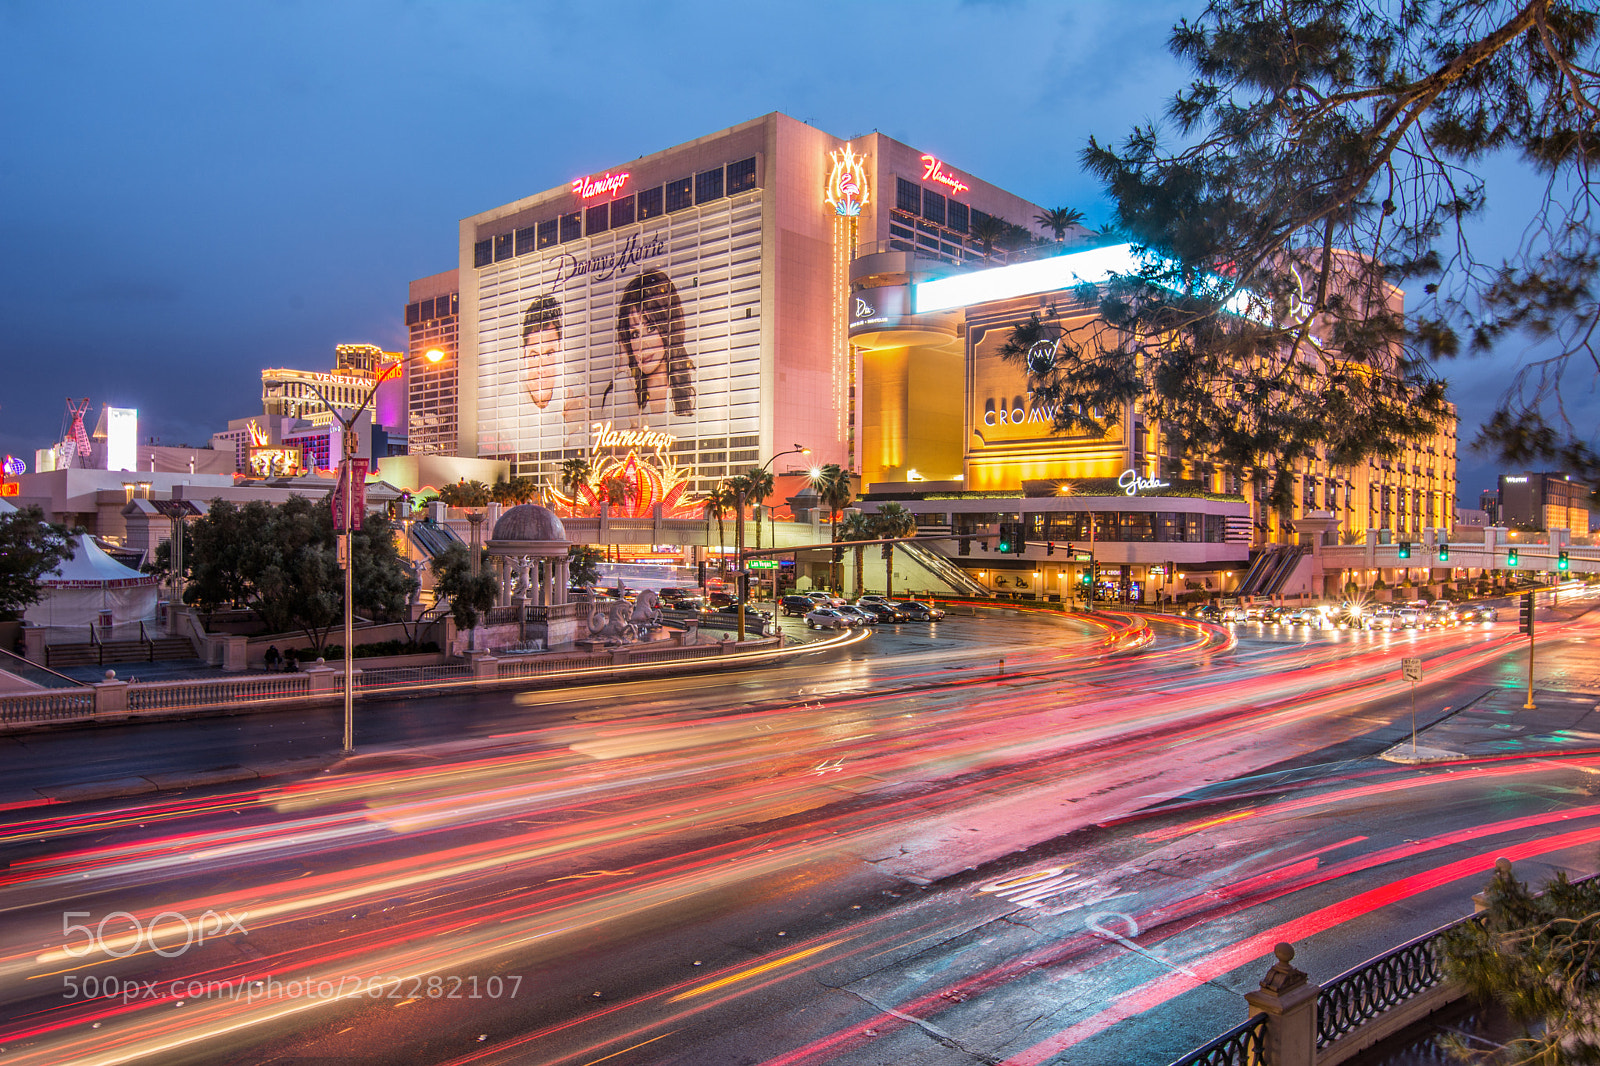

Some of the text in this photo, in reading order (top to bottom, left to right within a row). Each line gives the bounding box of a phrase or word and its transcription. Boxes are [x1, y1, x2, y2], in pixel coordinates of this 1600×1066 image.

[572, 172, 630, 199] Flamingo
[921, 154, 969, 195] Flamingo
[549, 253, 606, 291] Donny
[594, 230, 664, 281] Marie
[316, 372, 372, 387] VENETIAN
[984, 403, 1105, 426] CROMWL
[591, 421, 677, 456] Flamingo
[1118, 468, 1170, 495] Giada
